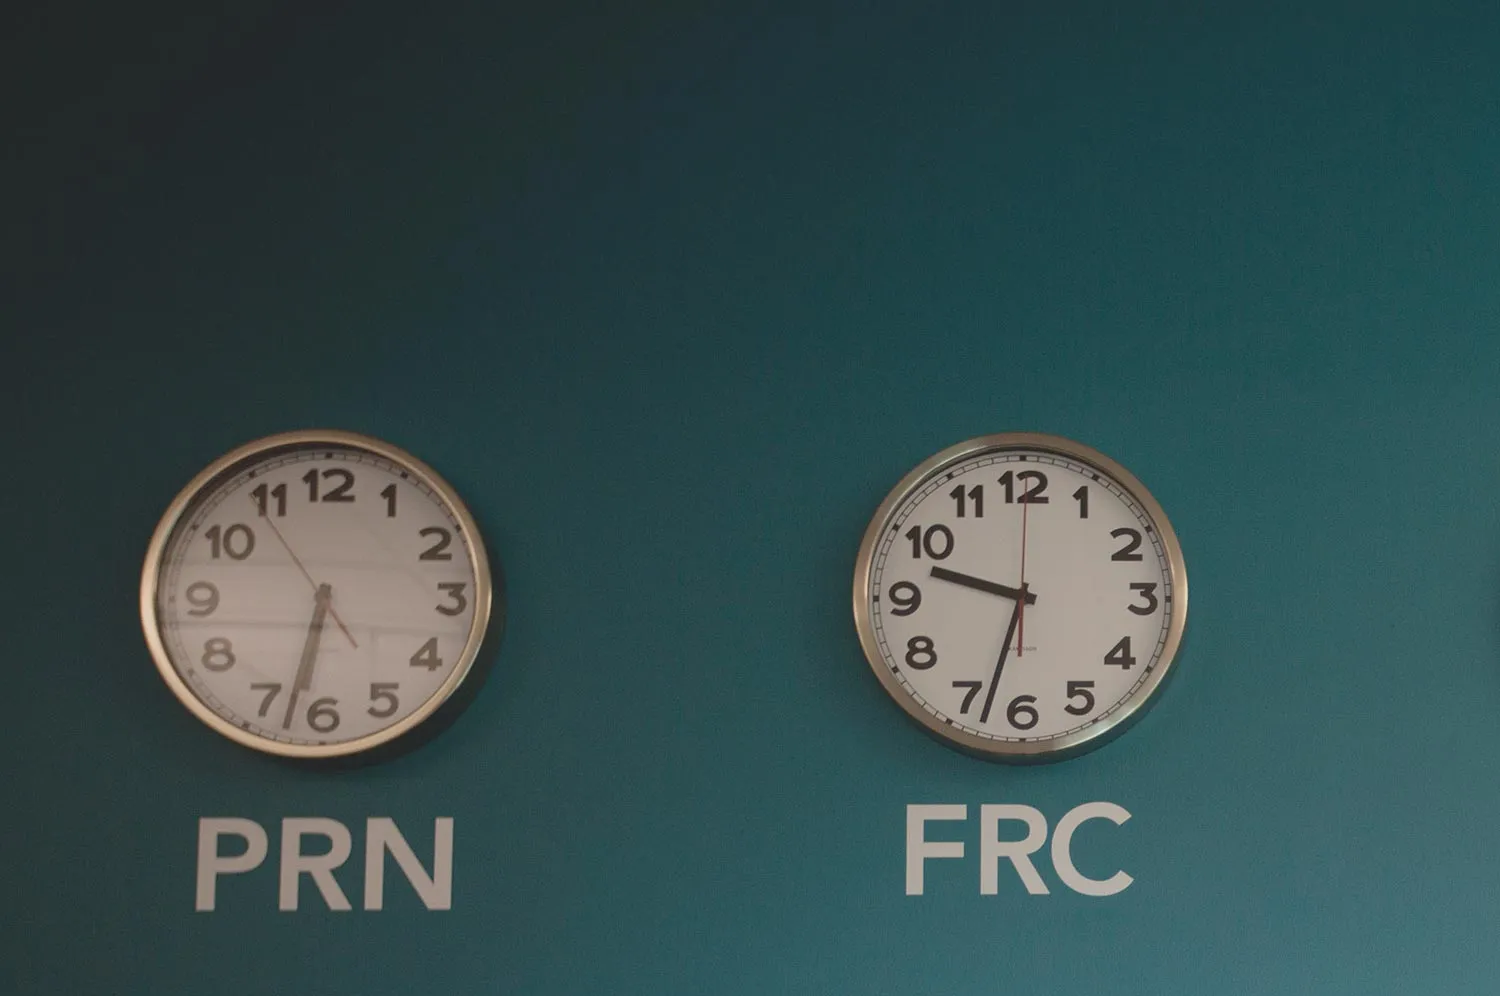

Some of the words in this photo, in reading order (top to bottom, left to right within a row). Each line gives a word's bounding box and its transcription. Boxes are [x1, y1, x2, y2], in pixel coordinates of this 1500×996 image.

[249, 483, 287, 517] 11
[301, 467, 355, 503] 12
[380, 483, 397, 518] 1
[949, 484, 984, 518] 11
[997, 470, 1049, 504] 12
[1072, 485, 1089, 519] 1
[204, 523, 255, 561] 10
[418, 526, 453, 561] 2
[904, 523, 955, 561] 10
[1109, 527, 1143, 562] 2
[185, 580, 220, 618] 9
[435, 581, 468, 617] 3
[888, 580, 922, 617] 9
[1127, 582, 1159, 616] 3
[201, 637, 237, 673] 8
[409, 636, 443, 672] 4
[904, 635, 938, 671] 8
[1103, 635, 1137, 670] 4
[250, 682, 282, 718] 7
[306, 697, 340, 734] 6
[367, 682, 399, 719] 5
[951, 680, 983, 715] 7
[1006, 694, 1039, 731] 6
[1063, 680, 1095, 716] 5
[195, 816, 454, 912] PRN
[905, 801, 1135, 897] FRC
